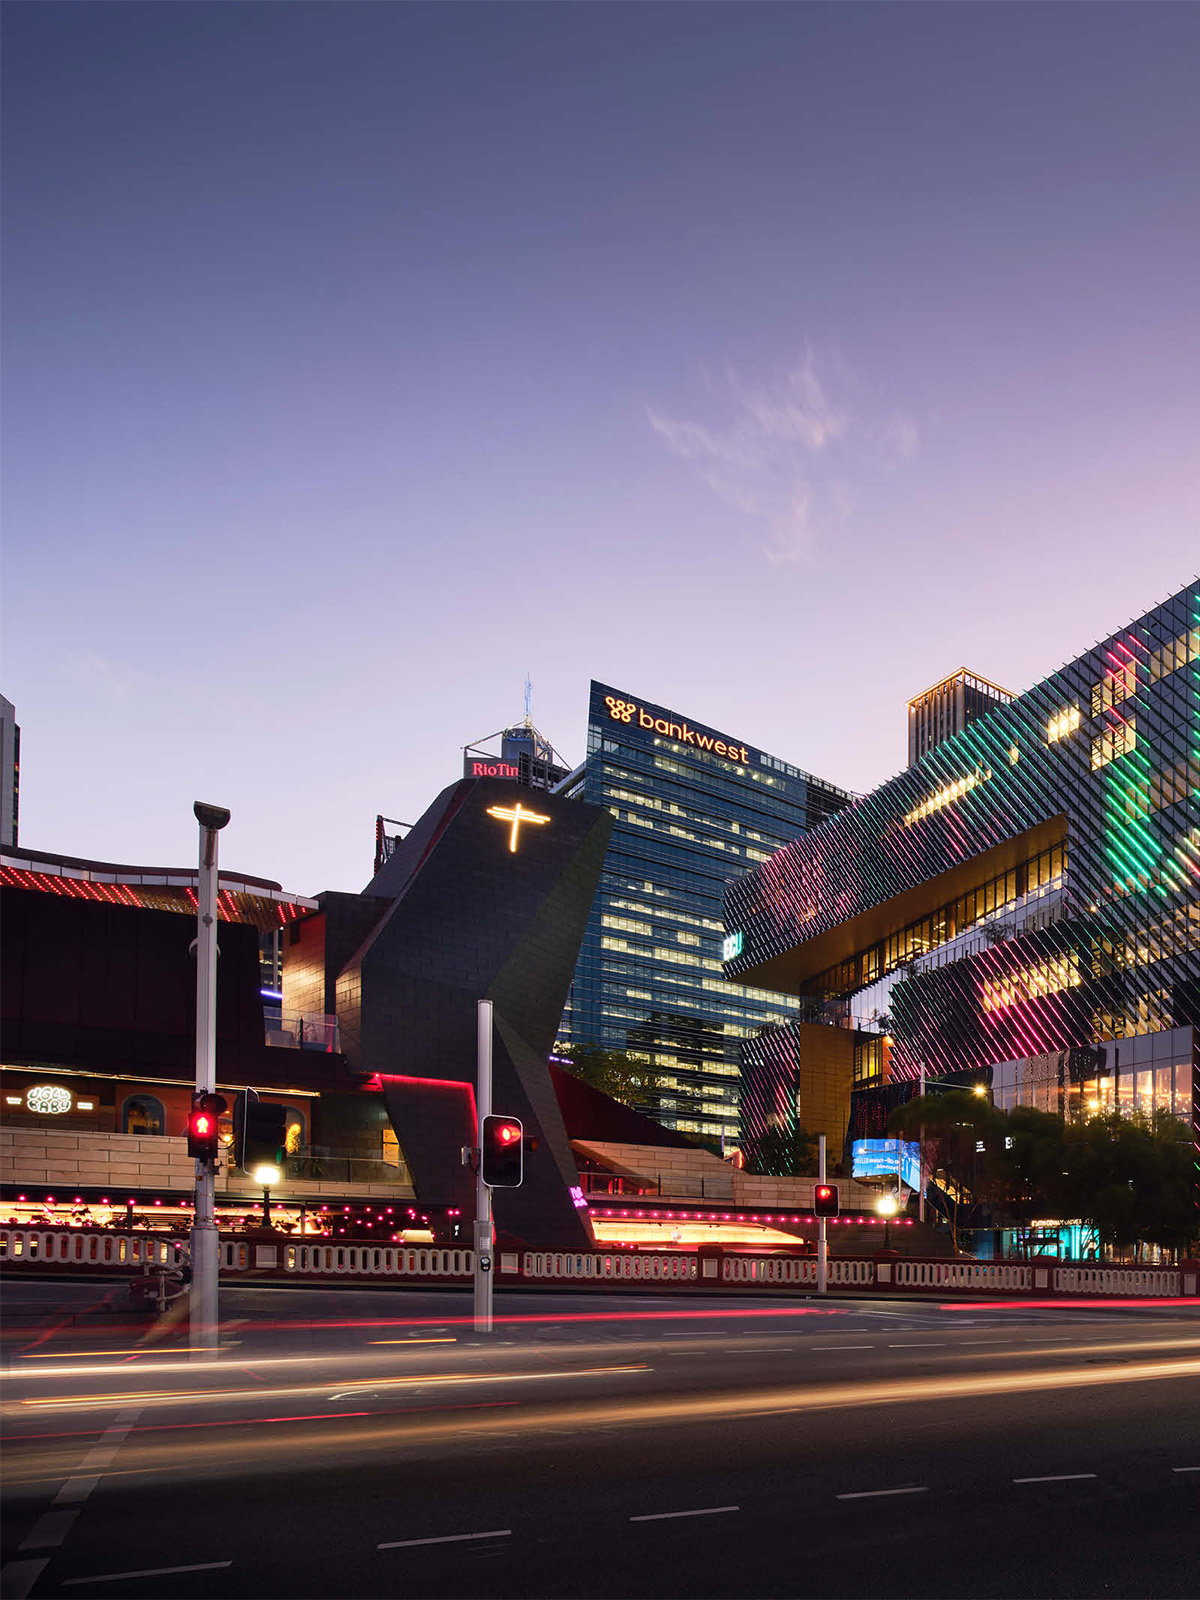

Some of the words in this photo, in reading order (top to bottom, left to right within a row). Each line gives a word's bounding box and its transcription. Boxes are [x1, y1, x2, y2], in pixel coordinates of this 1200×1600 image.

[639, 707, 750, 765] bankwest
[723, 932, 742, 961] ECU
[27, 1086, 71, 1100] UGLY
[27, 1099, 72, 1114] BABY
